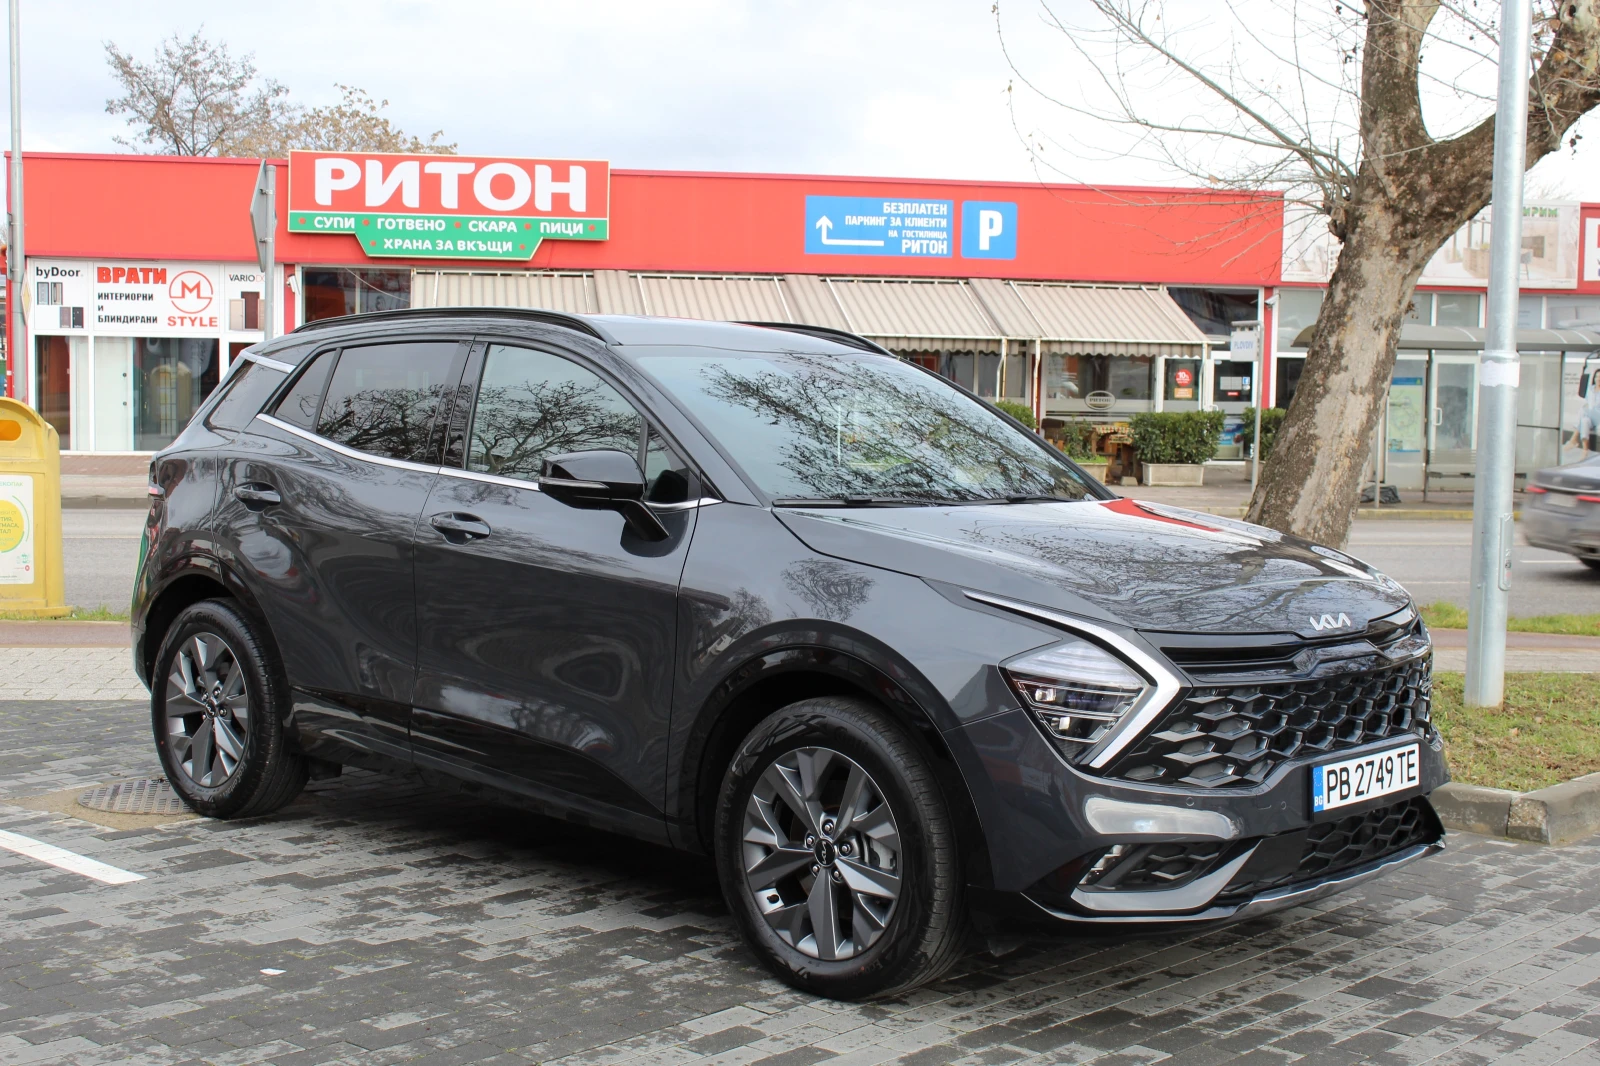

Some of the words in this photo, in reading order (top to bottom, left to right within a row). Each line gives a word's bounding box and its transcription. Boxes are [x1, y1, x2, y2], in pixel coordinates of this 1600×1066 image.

[315, 158, 586, 212] РИТОН
[883, 202, 947, 216] БЕЗПЛАТЕН
[1522, 206, 1558, 218] ИРИМ
[314, 216, 355, 229] СУПИ
[377, 218, 446, 231] ГОТВЕНО
[468, 220, 517, 233] СКАРА
[540, 221, 583, 236] ПИЦИ
[845, 215, 887, 227] ПАРКИНГ
[890, 216, 902, 227] ЗА
[905, 217, 947, 228] КЛИЕНТИ
[888, 230, 898, 238] НА
[902, 230, 947, 239] ГОСТИЛНИЦА
[979, 210, 1003, 251] P
[383, 238, 432, 250] ХРАНА
[436, 239, 453, 251] ЗА
[457, 240, 512, 253] ВКЪЩИ
[902, 239, 947, 254] РИТОН
[36, 266, 80, 279] byDoor
[97, 267, 167, 284] ВРАТИ
[97, 292, 154, 301] ИНТЕРИОРНИ
[97, 314, 158, 325] БЛИНДИРАНИ
[167, 316, 218, 328] STYLE
[1309, 612, 1351, 631] KIA
[1326, 766, 1351, 804] PB
[1355, 756, 1394, 797] 2749
[1397, 750, 1416, 785] TE
[1314, 794, 1323, 806] BG
